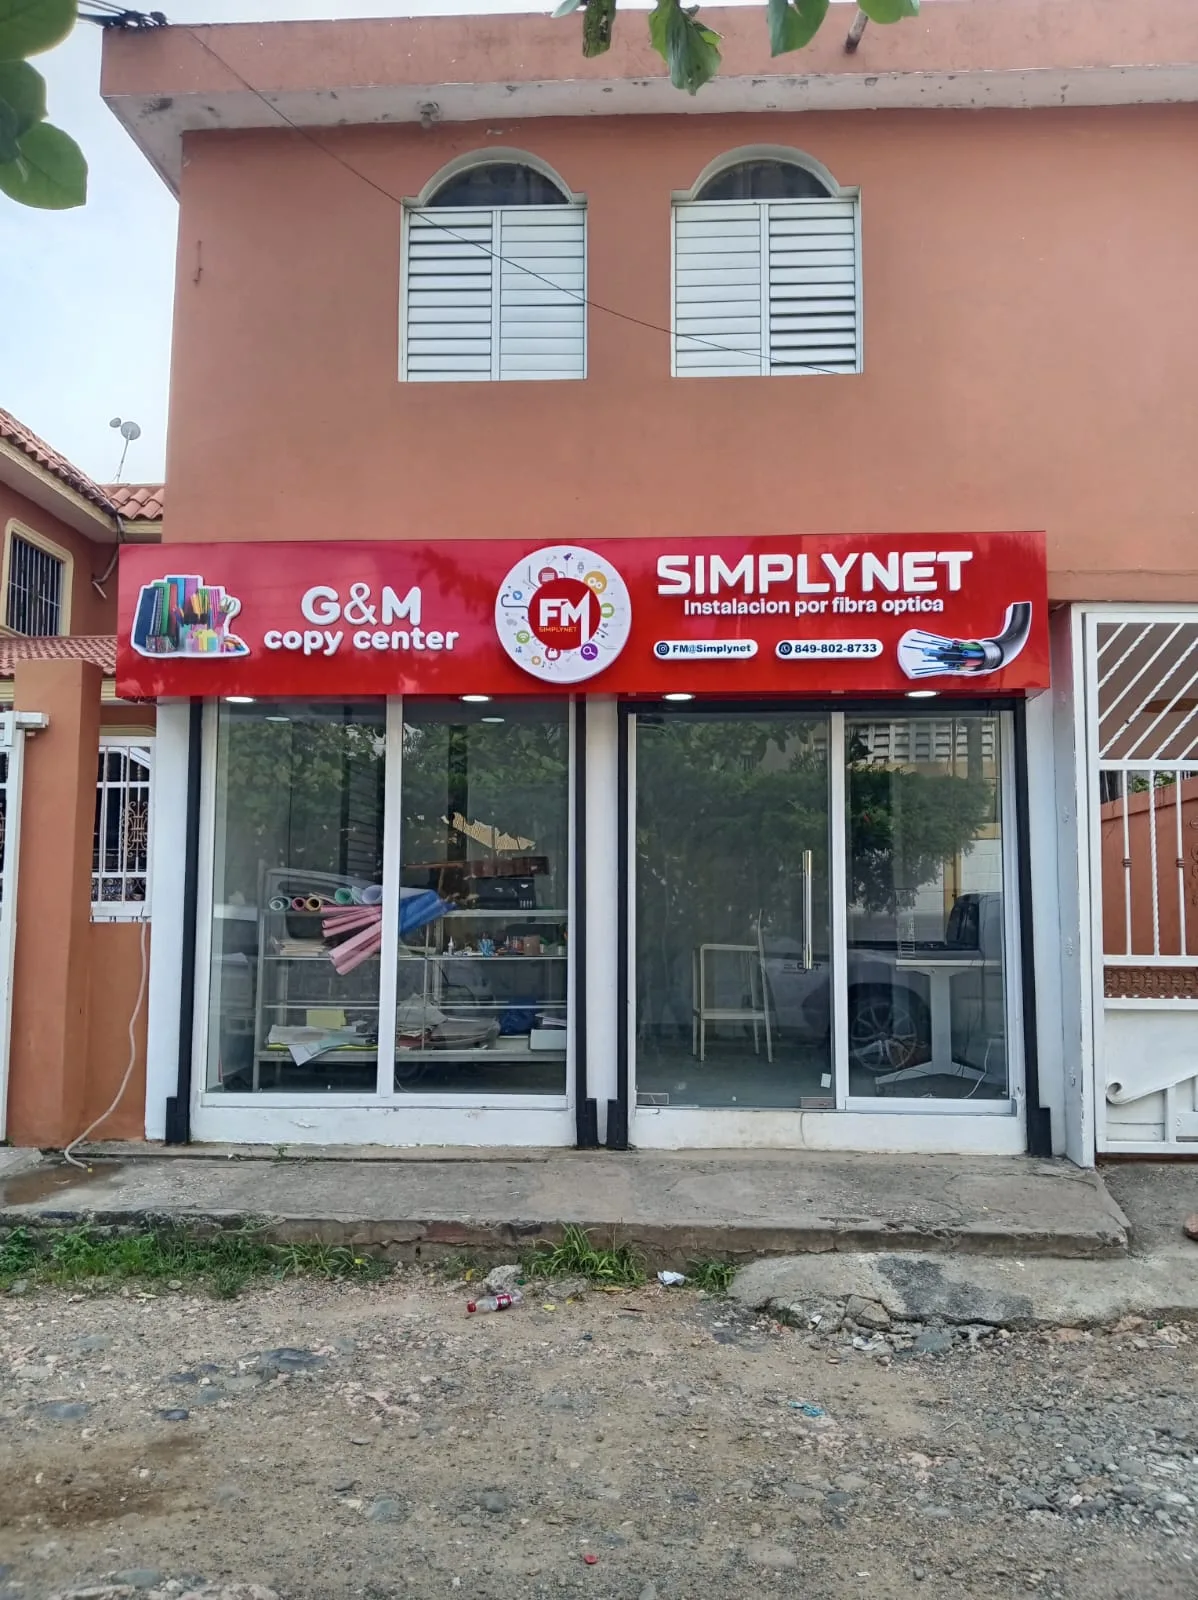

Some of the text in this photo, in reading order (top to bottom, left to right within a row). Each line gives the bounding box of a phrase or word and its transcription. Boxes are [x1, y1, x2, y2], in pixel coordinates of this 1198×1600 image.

[657, 552, 973, 594] SIMPLYNET
[302, 582, 422, 625] G&M
[684, 596, 944, 617] Instalacion por fibra optica
[539, 626, 577, 634] SIMPLYNET
[540, 590, 590, 646] FM
[264, 627, 459, 655] copy center
[794, 644, 877, 654] 849-802-8733
